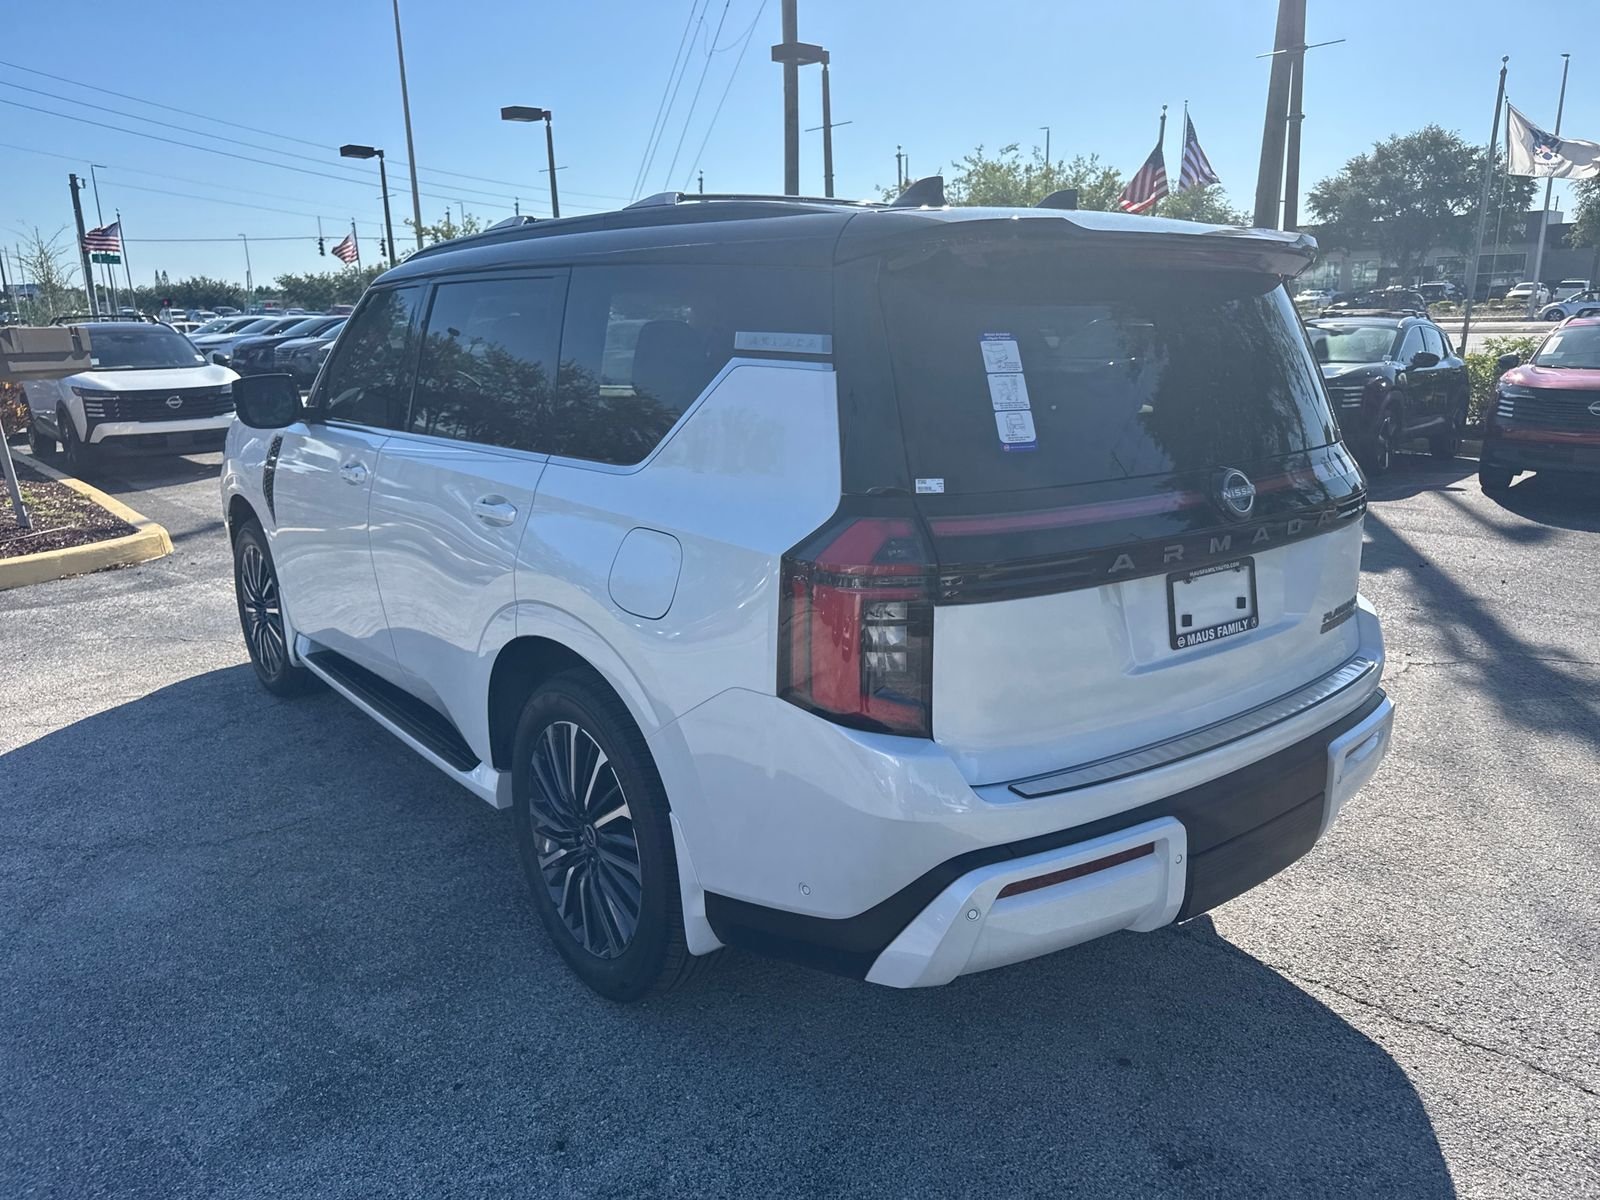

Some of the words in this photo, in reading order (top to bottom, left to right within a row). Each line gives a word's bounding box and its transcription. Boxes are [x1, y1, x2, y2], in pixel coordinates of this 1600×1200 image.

[1108, 511, 1333, 573] ARMADA
[1187, 628, 1215, 646] MAUS
[1217, 619, 1248, 638] FAMILY
